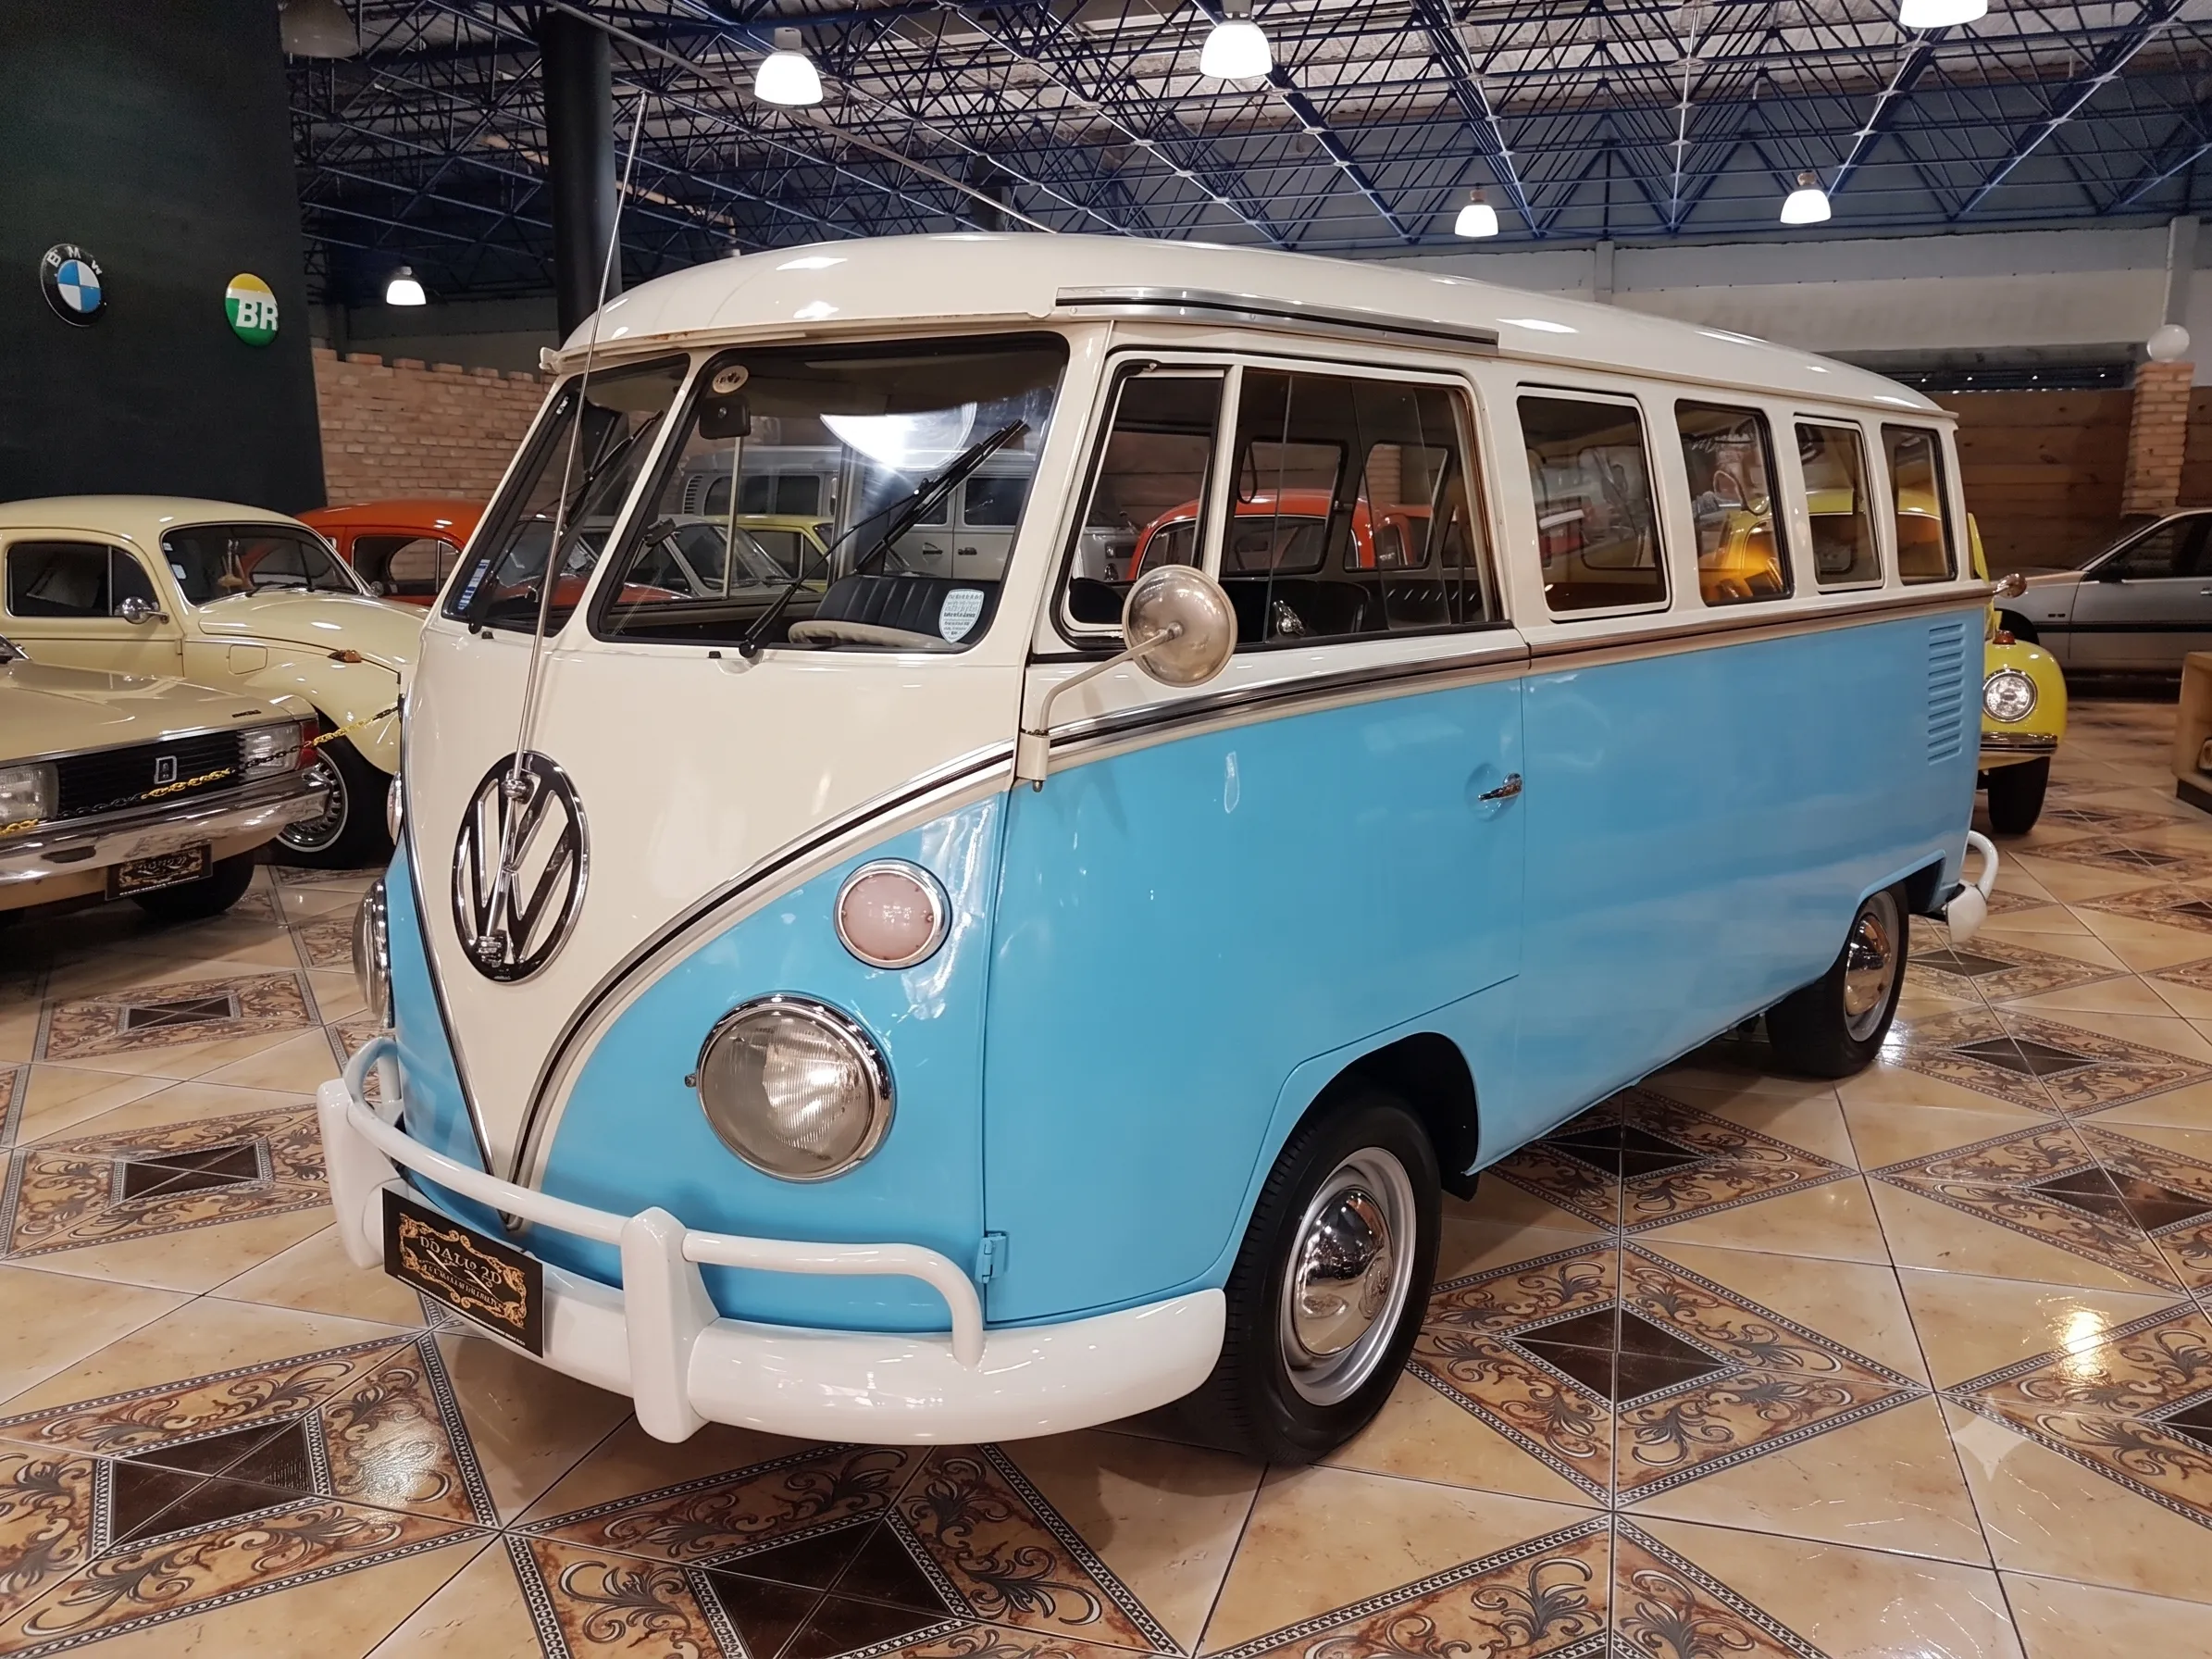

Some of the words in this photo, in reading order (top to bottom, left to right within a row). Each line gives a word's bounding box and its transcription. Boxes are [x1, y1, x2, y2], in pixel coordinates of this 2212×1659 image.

[46, 245, 103, 275] BMW
[235, 299, 279, 331] BR
[460, 755, 583, 979] VW
